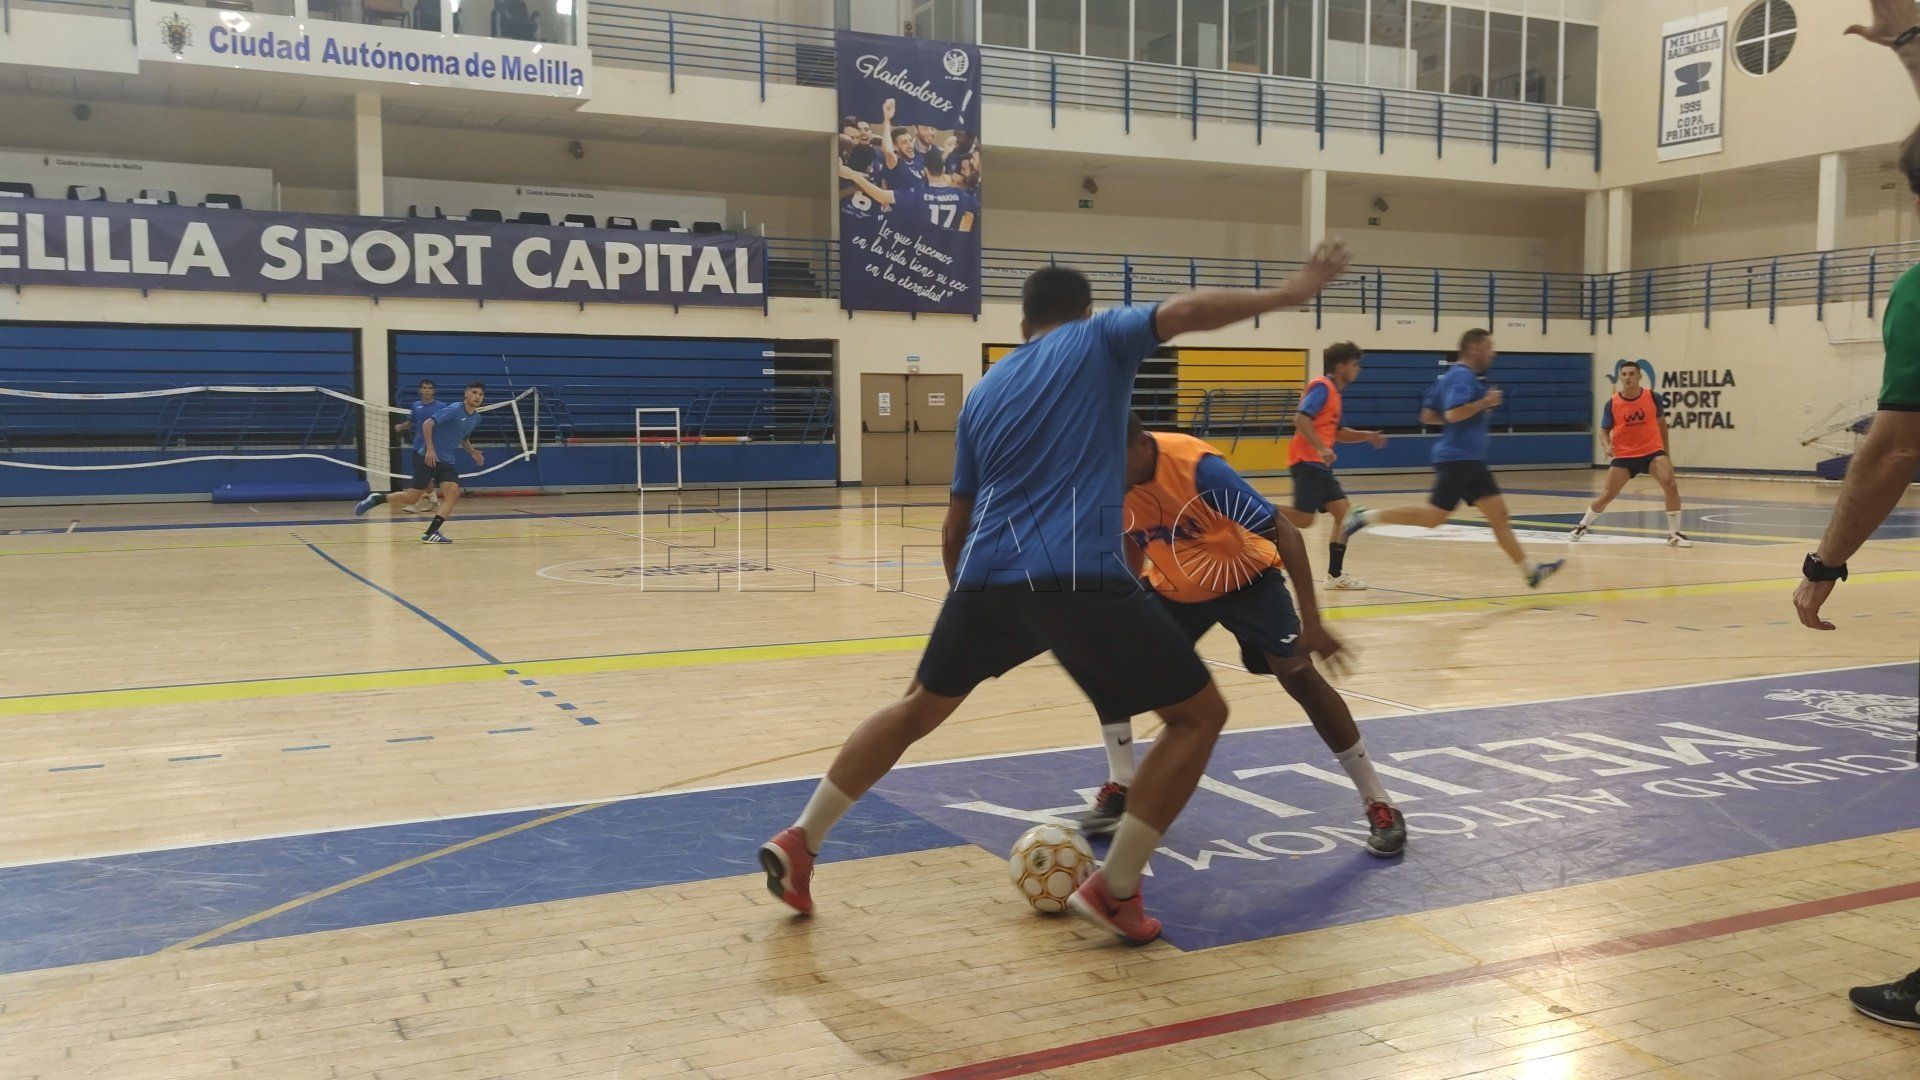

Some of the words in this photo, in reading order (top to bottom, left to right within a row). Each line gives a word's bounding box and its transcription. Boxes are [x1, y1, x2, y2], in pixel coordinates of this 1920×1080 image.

[1670, 28, 1719, 49] MELILLA
[209, 25, 311, 62] Ciudad
[322, 37, 460, 76] Autónoma
[465, 52, 496, 78] de
[502, 54, 584, 87] Melilla
[856, 54, 953, 112] Gladiadores
[1666, 122, 1716, 141] PRINCIPE
[1676, 115, 1704, 128] COPA
[929, 204, 957, 228] 17
[260, 224, 492, 286] SPORT
[512, 236, 763, 294] CAPITAL
[894, 232, 912, 250] que
[914, 235, 954, 265] hacemos
[852, 236, 868, 249] en
[870, 236, 884, 255] la
[886, 249, 907, 266] vida
[909, 257, 935, 278] tiene
[949, 279, 971, 292] eco
[865, 263, 881, 277] en
[883, 264, 897, 282] la
[1661, 369, 1736, 388] MELILLA
[1661, 390, 1722, 409] SPORT
[1641, 753, 1919, 799] CIUDAD
